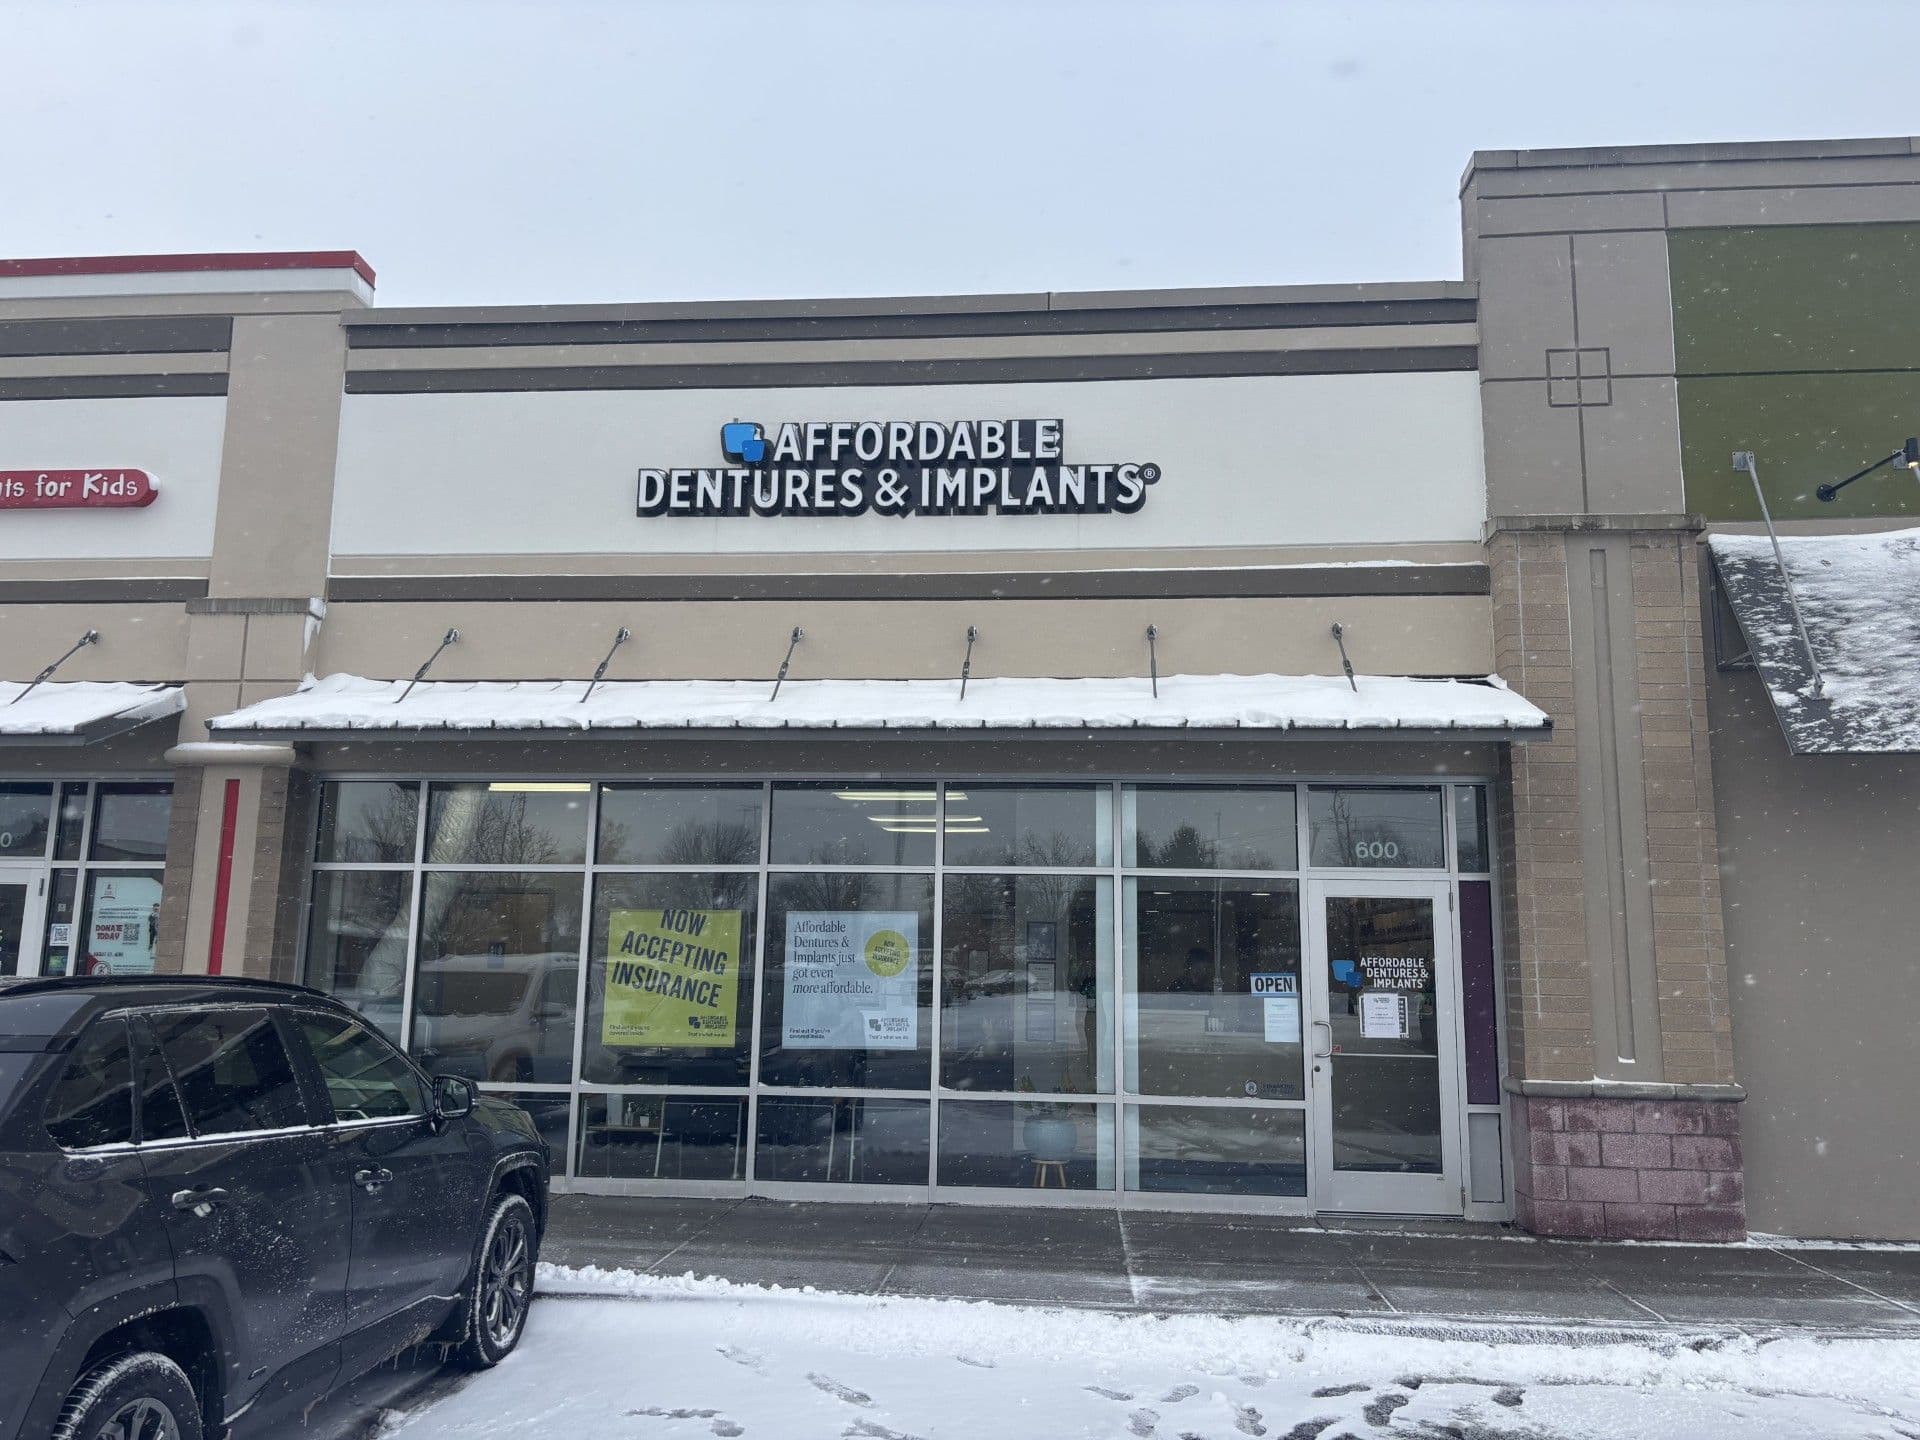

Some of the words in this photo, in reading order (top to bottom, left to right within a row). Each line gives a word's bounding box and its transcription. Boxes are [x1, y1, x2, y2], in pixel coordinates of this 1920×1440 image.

[773, 419, 1062, 462] AFFORDABLE
[0, 478, 25, 498] ts
[35, 473, 72, 498] for
[82, 472, 139, 499] Kids
[637, 467, 864, 508] DENTURES
[873, 470, 909, 508] &
[1355, 841, 1398, 859] 600
[661, 909, 707, 936] NOW
[794, 920, 846, 933] Affordable
[794, 935, 839, 948] Dentures
[841, 935, 850, 948] &
[620, 930, 728, 976] ACCEPTING
[794, 951, 837, 965] Implants
[836, 950, 856, 967] just
[1360, 957, 1425, 968] AFFORDABLE
[792, 968, 808, 981] got
[811, 968, 834, 978] even
[1366, 967, 1418, 978] DENTURES
[1420, 968, 1429, 979] &
[611, 960, 722, 1008] INSURANCE
[792, 983, 820, 994] more
[820, 981, 873, 994] affordable.
[1254, 977, 1293, 992] OPEN
